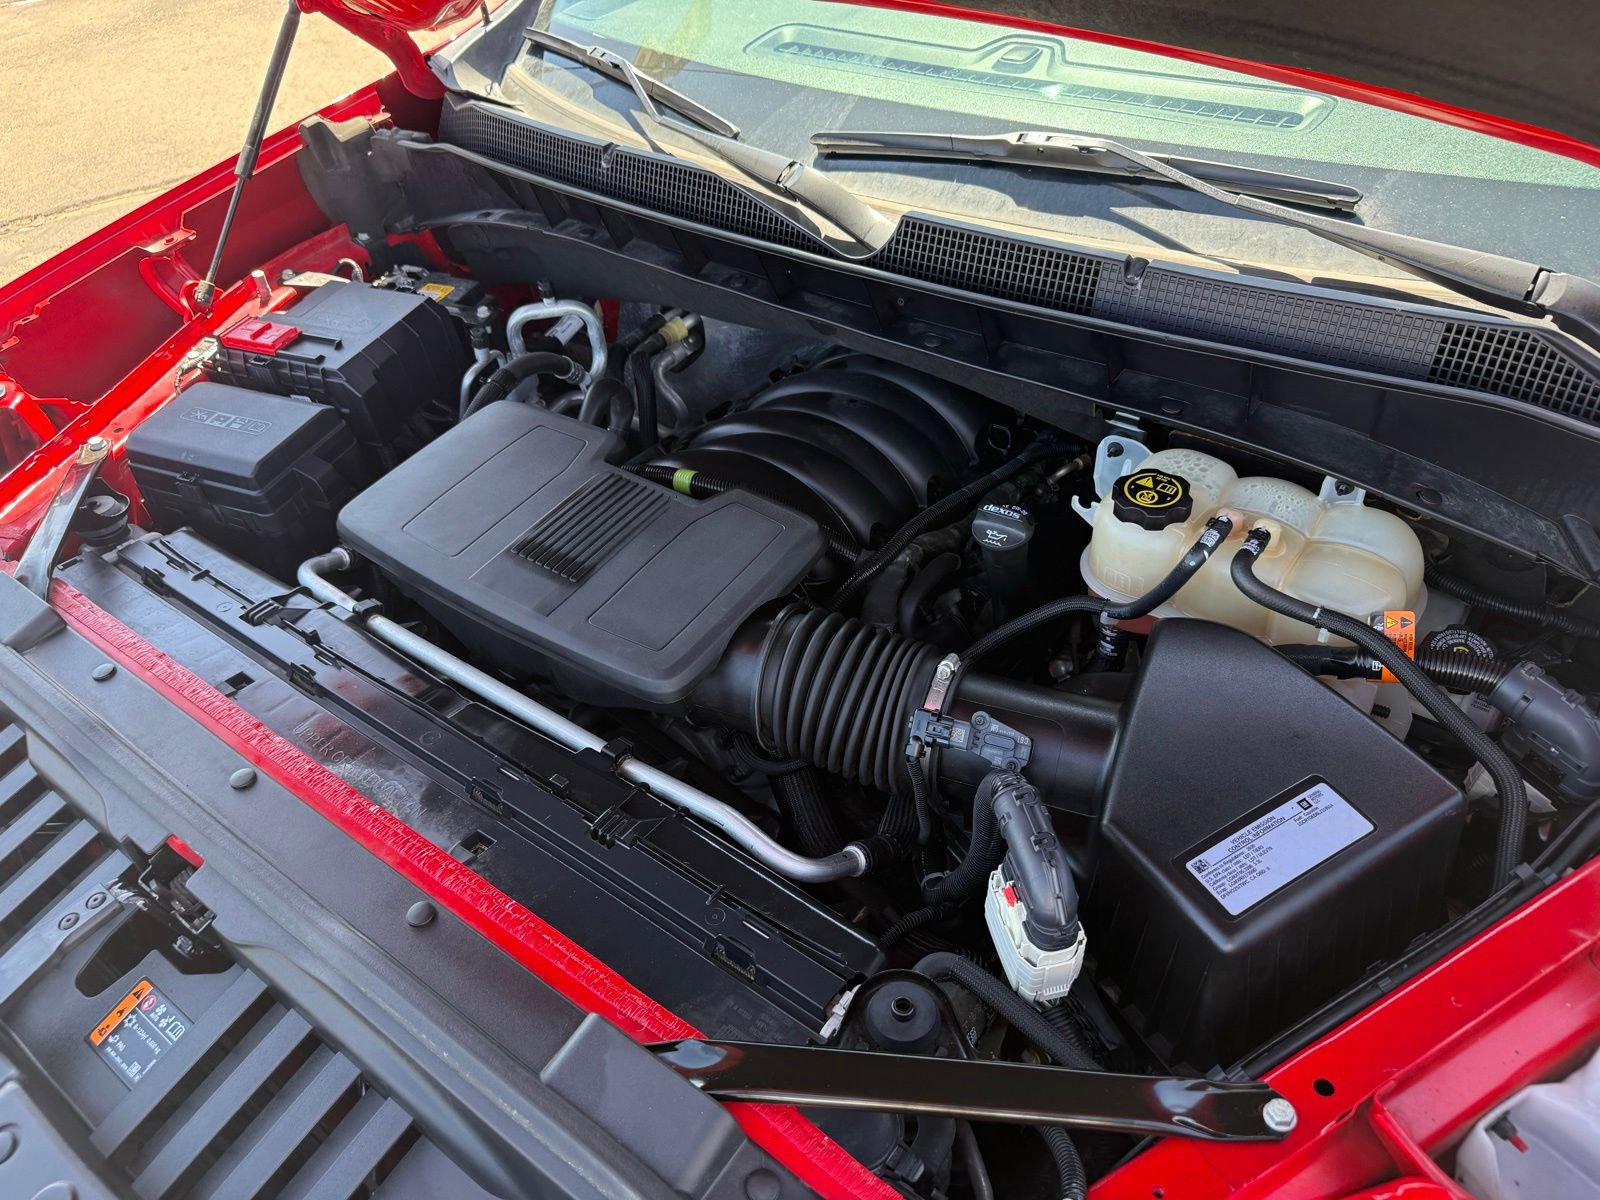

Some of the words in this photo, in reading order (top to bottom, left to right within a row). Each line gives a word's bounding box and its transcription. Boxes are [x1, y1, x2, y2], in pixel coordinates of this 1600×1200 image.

[984, 504, 1020, 518] dexos
[292, 721, 335, 757] UPPER
[1228, 836, 1253, 853] CONTROL
[1252, 817, 1286, 838] INFORMATION
[1230, 830, 1253, 844] VEHICLE
[1251, 816, 1276, 832] EMISSION
